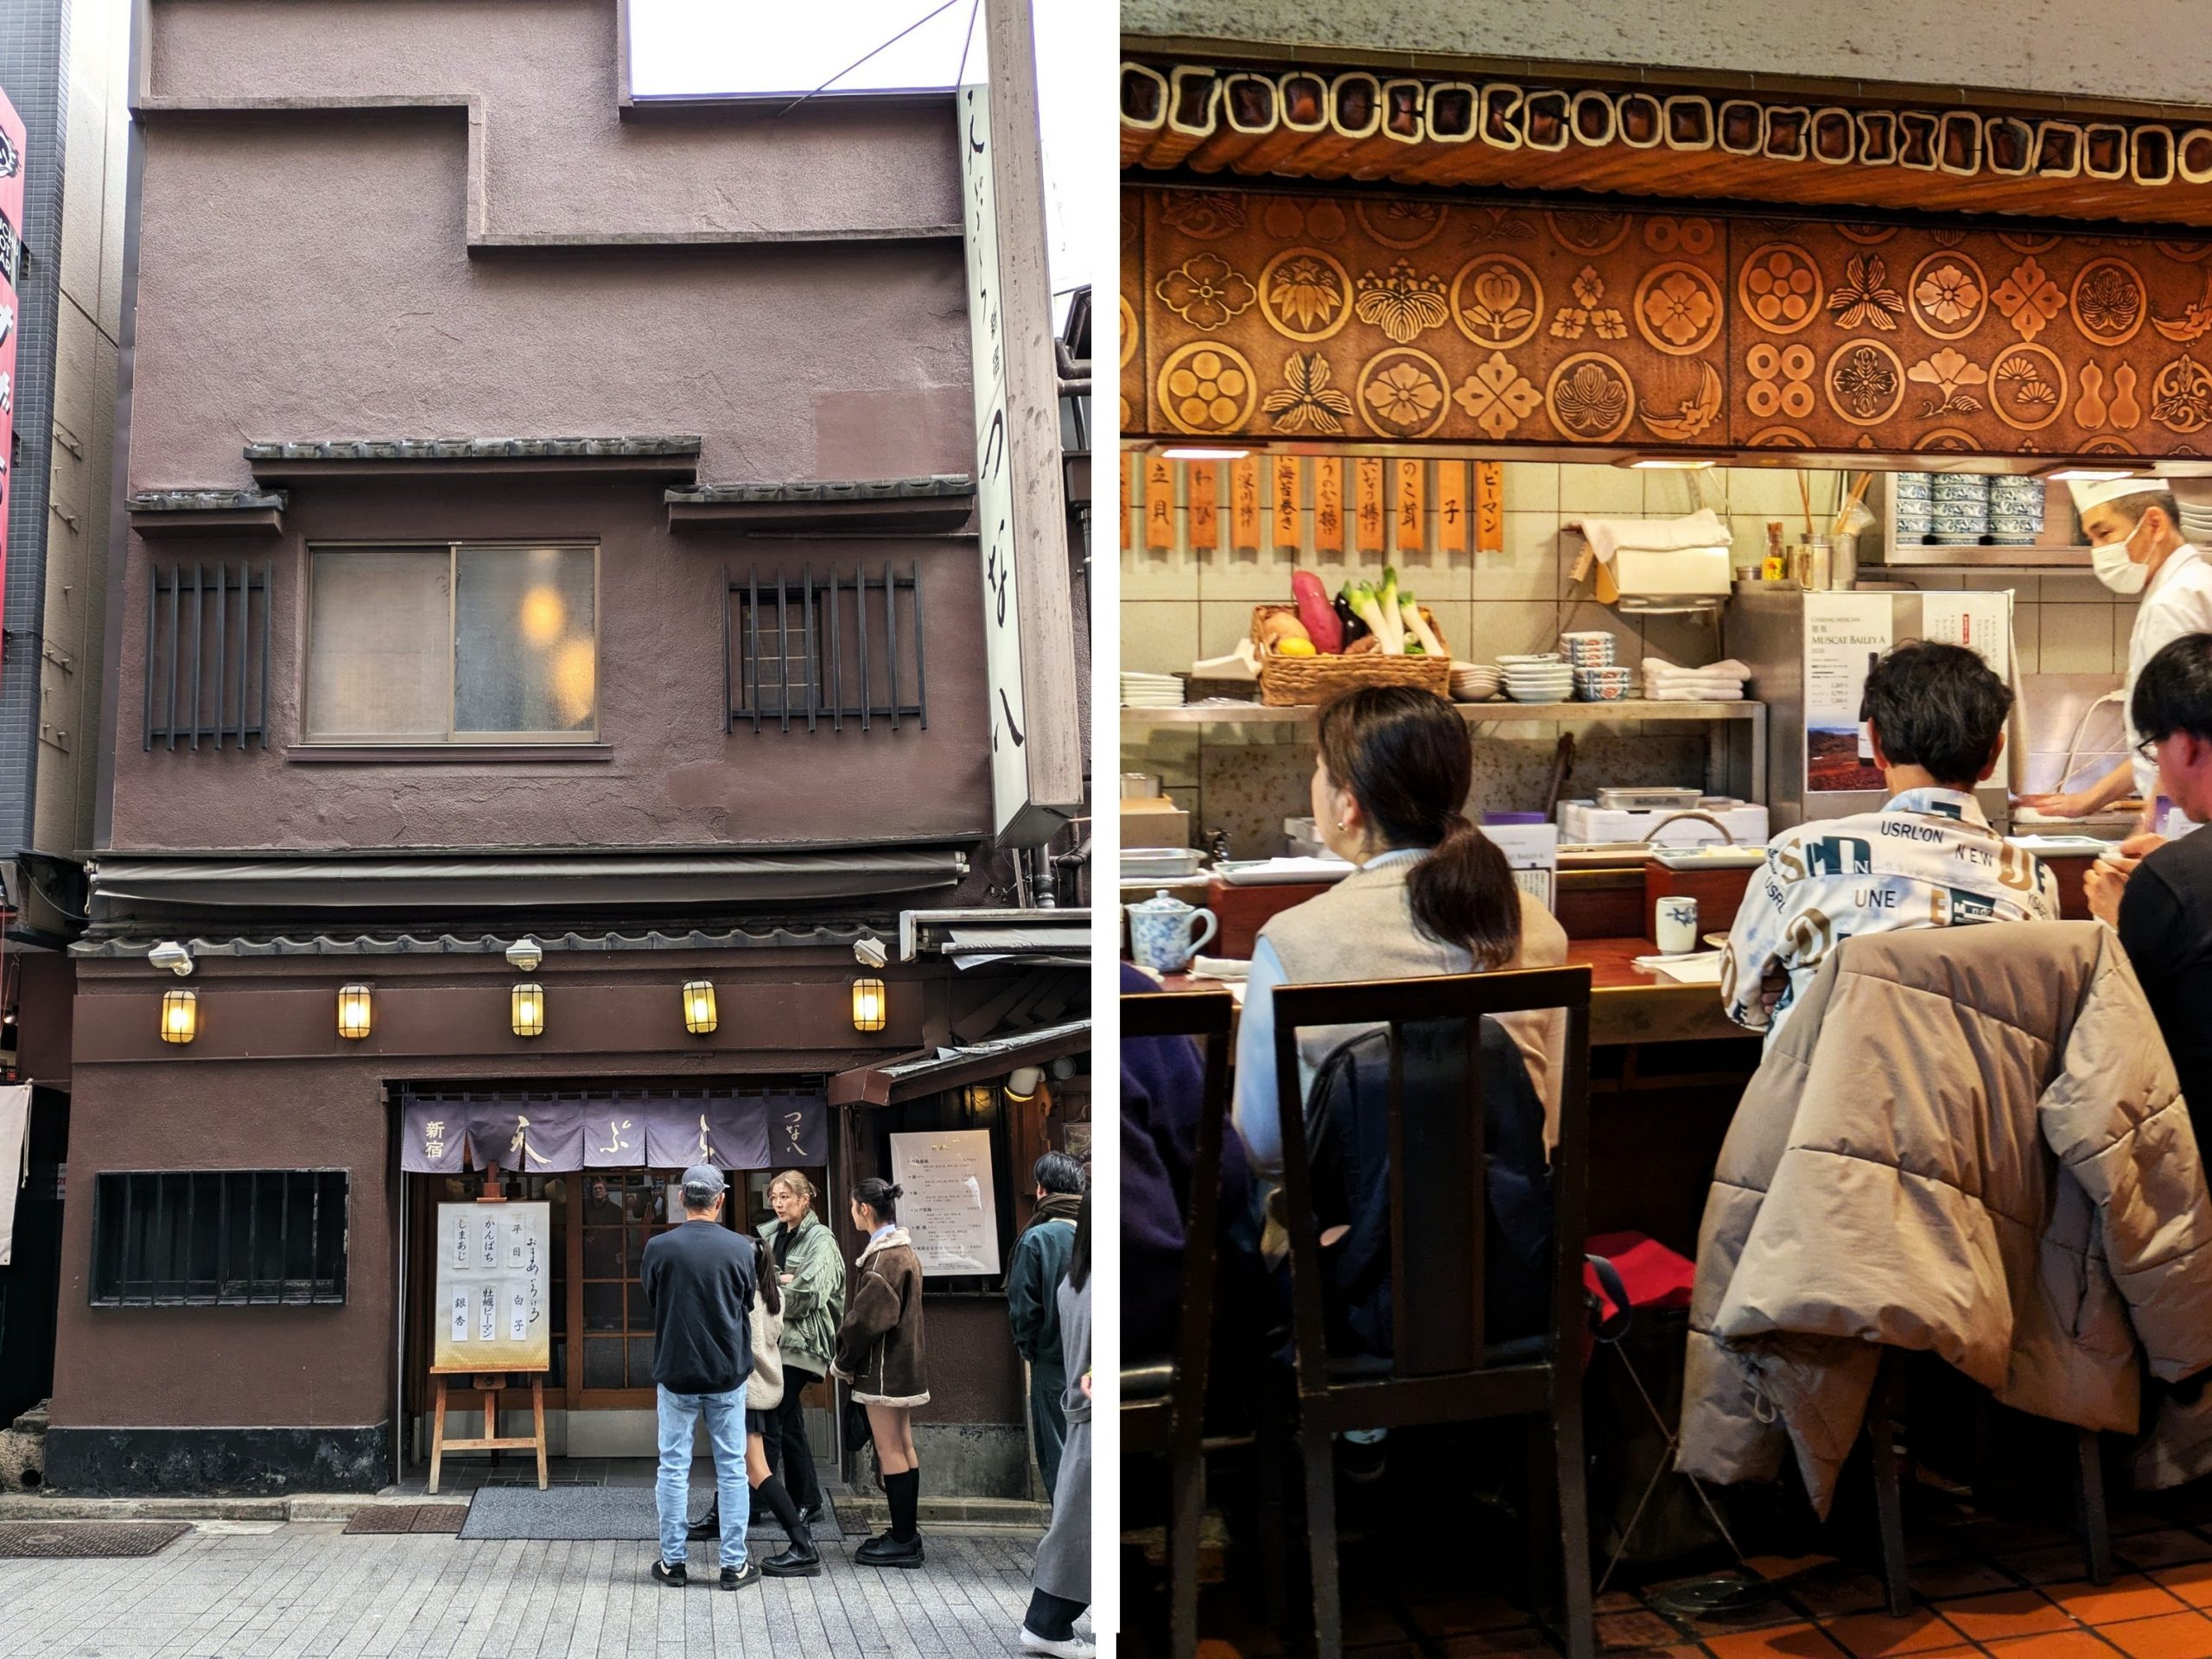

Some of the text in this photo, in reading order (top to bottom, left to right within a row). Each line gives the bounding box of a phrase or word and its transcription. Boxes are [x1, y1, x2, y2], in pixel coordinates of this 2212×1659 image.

[1444, 499, 1460, 524] 子
[1482, 461, 1499, 533] ピーマン
[1850, 635, 1878, 644] BAILEY
[1880, 820, 1944, 844] USRL'ON
[1854, 888, 1897, 909] UNE
[425, 1121, 445, 1159] 新宿
[784, 1111, 808, 1157] つな八
[456, 1219, 467, 1262] しまあじ
[511, 1224, 523, 1257] 平目
[454, 1298, 466, 1326] 銀杏
[513, 1295, 524, 1332] 白子
